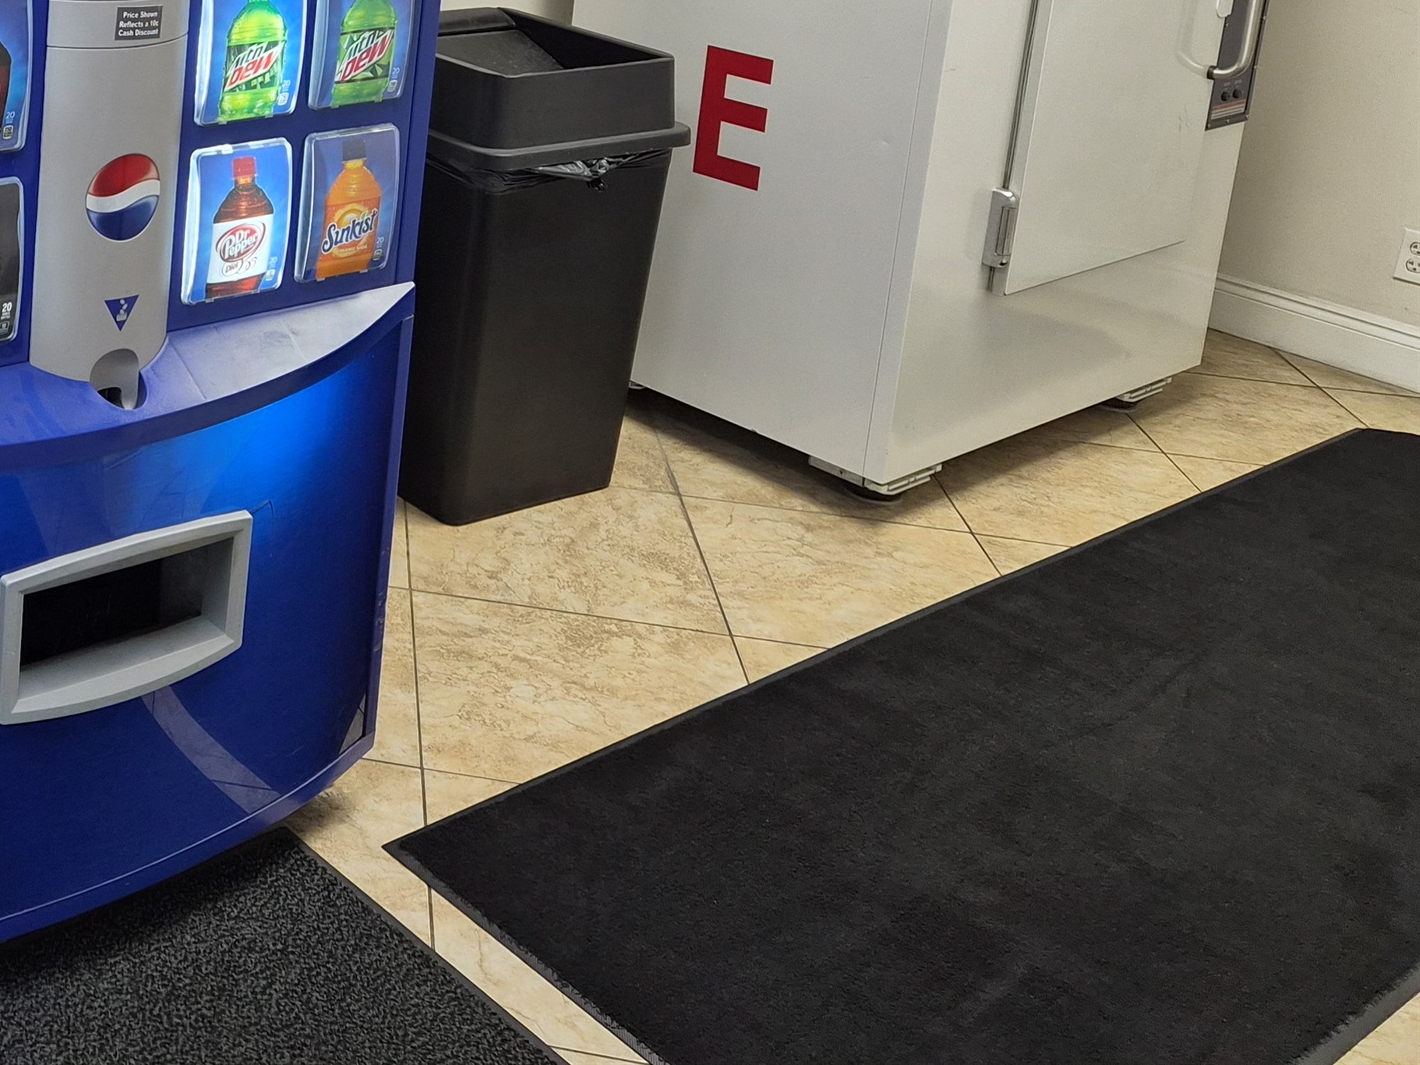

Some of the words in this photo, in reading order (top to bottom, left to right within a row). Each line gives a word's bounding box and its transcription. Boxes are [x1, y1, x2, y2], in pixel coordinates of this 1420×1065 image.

[6, 111, 16, 119] 20
[235, 229, 250, 242] Dr
[322, 210, 378, 253] Sunkist
[224, 233, 259, 258] Pepper
[2, 302, 12, 312] 20
